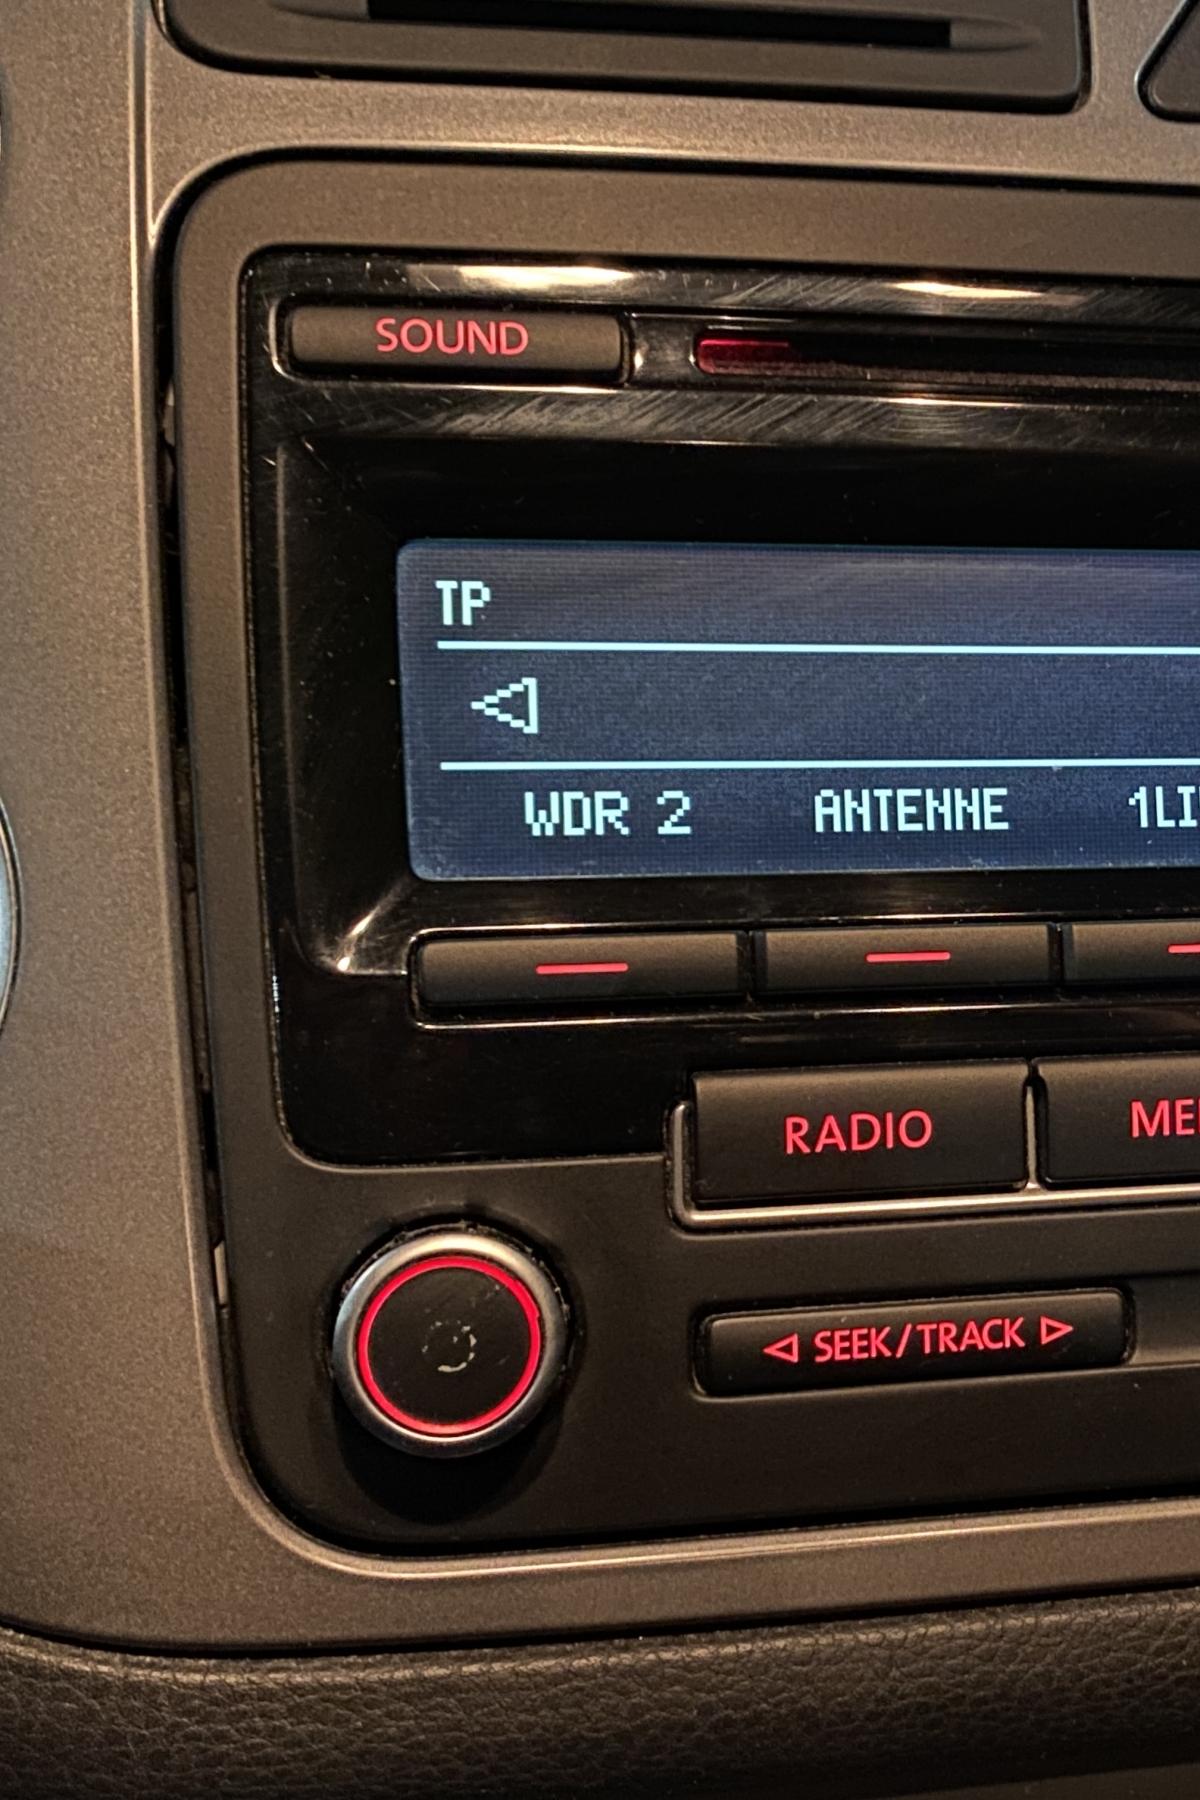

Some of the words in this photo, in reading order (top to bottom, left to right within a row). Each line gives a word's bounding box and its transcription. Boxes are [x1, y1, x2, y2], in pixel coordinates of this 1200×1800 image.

[375, 316, 530, 357] SOUND
[435, 579, 492, 627] TP
[523, 790, 630, 837] WDR
[656, 789, 692, 835] 2
[813, 786, 1009, 834] ANTENNE
[784, 1108, 934, 1156] RADIO
[813, 1316, 1027, 1365] SEEK/TRACK
